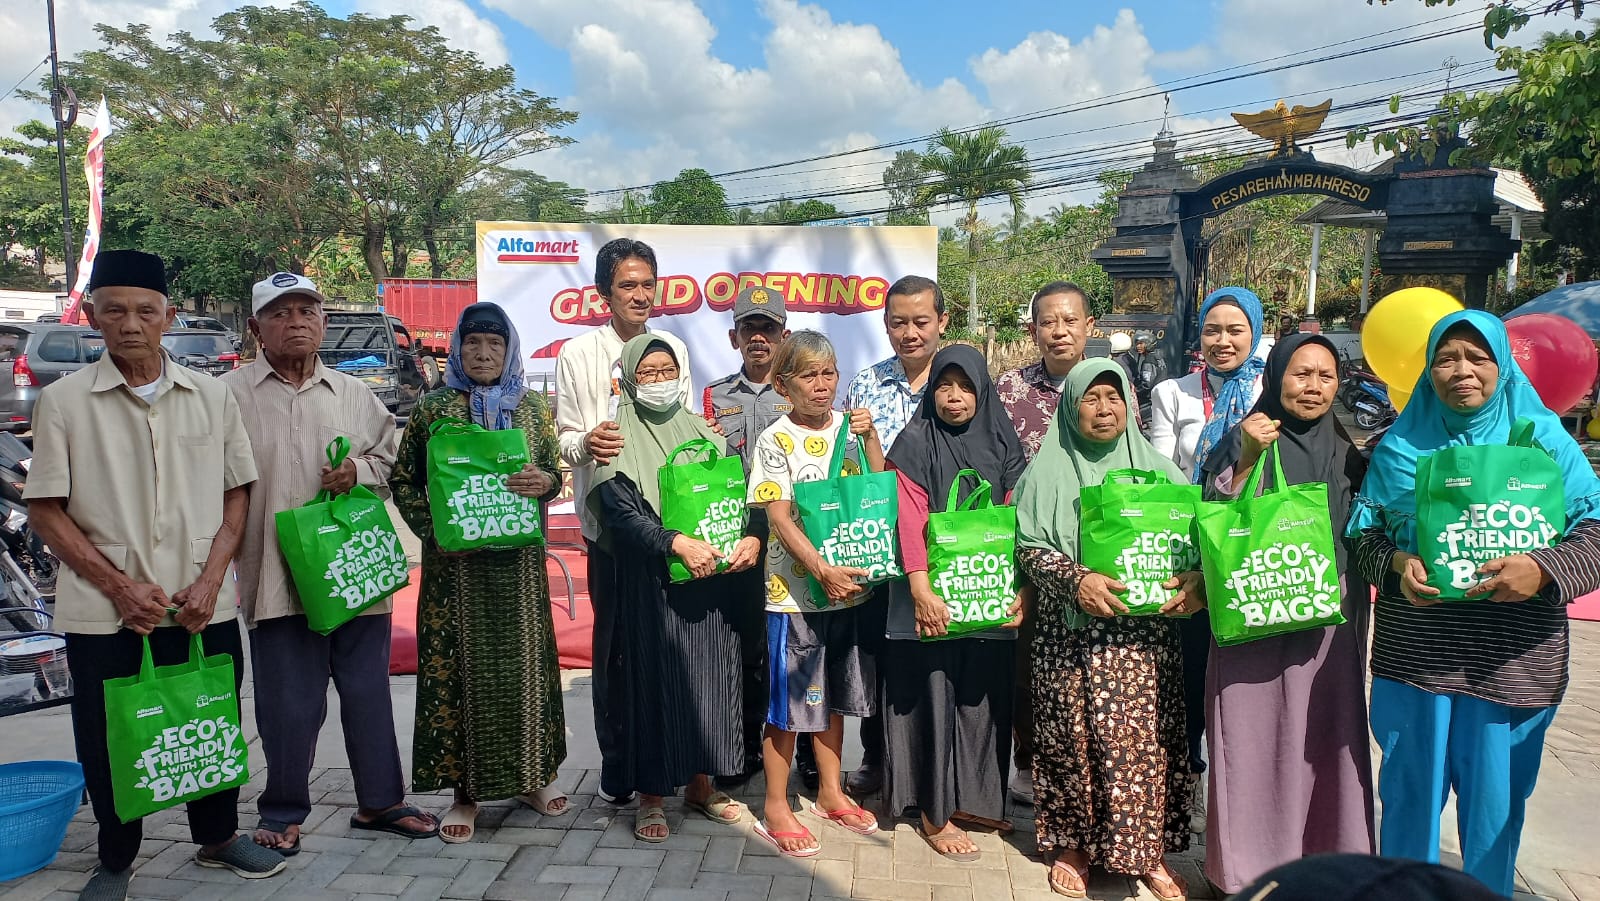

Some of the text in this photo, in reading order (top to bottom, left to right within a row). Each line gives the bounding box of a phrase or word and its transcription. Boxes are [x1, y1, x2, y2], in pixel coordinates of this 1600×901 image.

[497, 237, 579, 254] Alfamart
[475, 505, 517, 516] WITH THE
[710, 498, 740, 520] ECO
[1469, 504, 1532, 528] ECO
[459, 512, 534, 540] BAGS
[838, 520, 880, 542] ECO
[1141, 532, 1184, 554] ECO
[844, 554, 883, 566] WITH THE
[956, 554, 999, 576] ECO
[1250, 544, 1302, 573] ECO
[1472, 550, 1505, 560] WITH
[354, 560, 388, 582] WITH THE
[1144, 572, 1164, 580] WITH
[340, 562, 407, 609] BAGS
[960, 590, 998, 600] WITH THE
[1257, 585, 1308, 600] WITH THE
[1239, 593, 1334, 626] BAGS
[162, 720, 216, 750] ECO
[168, 756, 218, 774] WITH THE
[148, 758, 238, 802] BAGS
